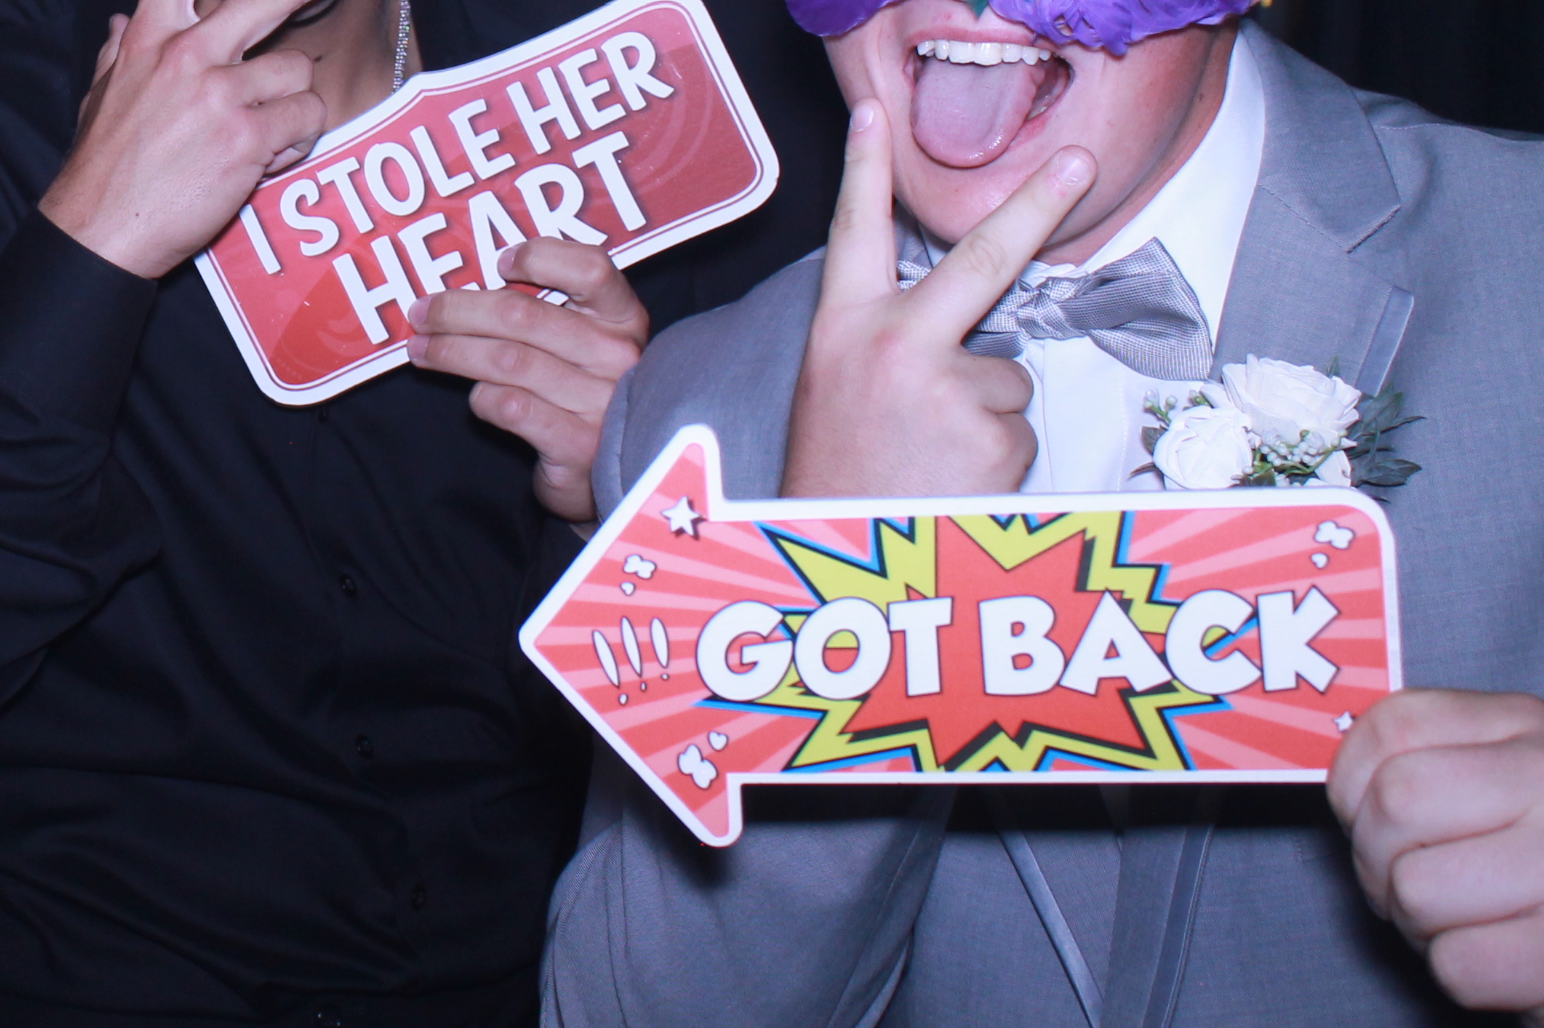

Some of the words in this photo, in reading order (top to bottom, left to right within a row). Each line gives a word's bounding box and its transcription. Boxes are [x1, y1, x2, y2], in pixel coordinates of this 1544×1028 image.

[241, 204, 281, 275] I
[280, 99, 515, 257] STOLE
[506, 31, 675, 155] HER
[332, 131, 647, 345] HEART
[696, 597, 953, 701] GOT
[978, 585, 1340, 696] BACK
